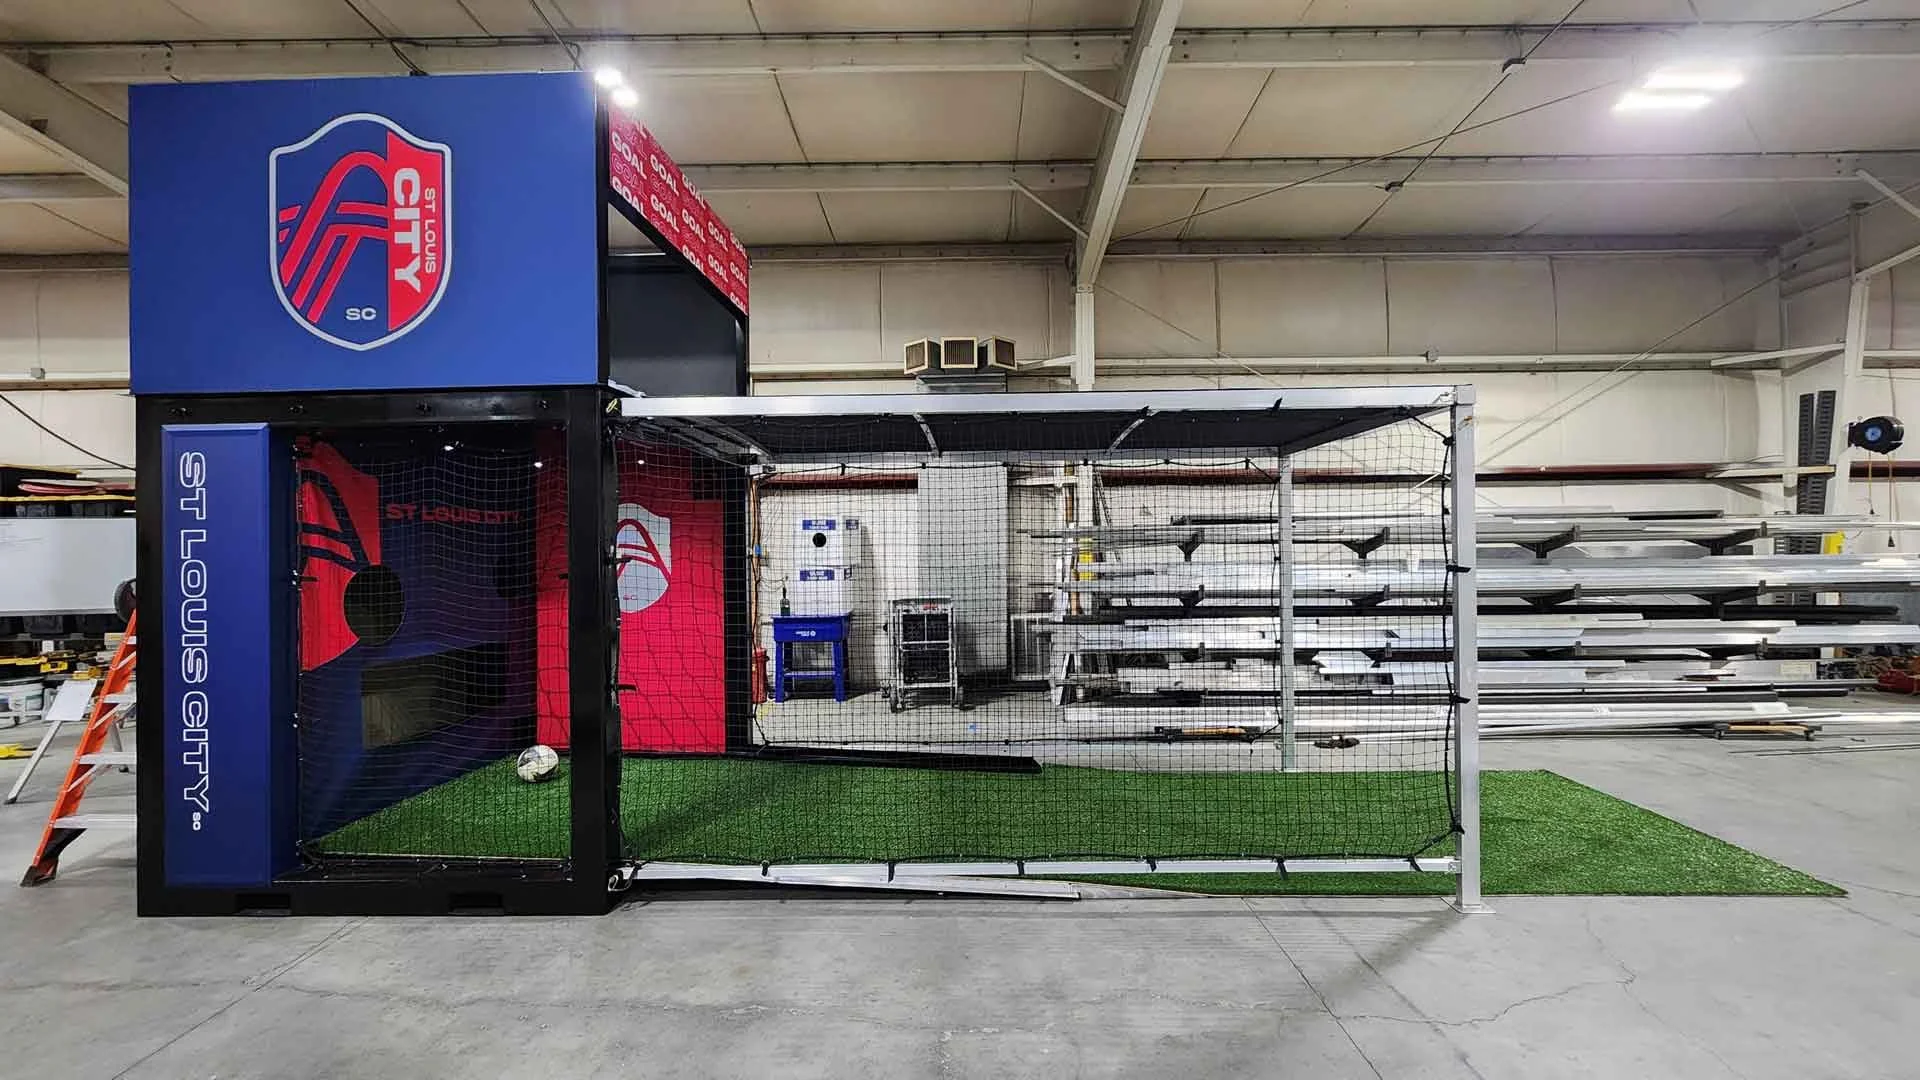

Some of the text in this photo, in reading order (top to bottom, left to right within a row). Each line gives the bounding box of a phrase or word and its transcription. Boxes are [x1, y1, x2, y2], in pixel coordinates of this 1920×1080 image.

[611, 131, 648, 180] GOAL
[650, 153, 680, 197] GOAL
[611, 176, 648, 219] GOAL
[682, 173, 706, 209] GOAL
[393, 167, 421, 293] CITY
[424, 187, 436, 274] ST LOUIS
[650, 193, 680, 233] GOAL
[682, 208, 706, 243] GOAL
[708, 221, 729, 252] GOAL
[682, 244, 706, 275] GOAL
[708, 254, 729, 282] GOAL
[730, 261, 748, 288] GOAL
[345, 307, 376, 321] SC
[180, 451, 207, 520] ST
[385, 503, 417, 520] ST
[181, 529, 209, 684] LOUIS
[182, 691, 209, 813] CITY
